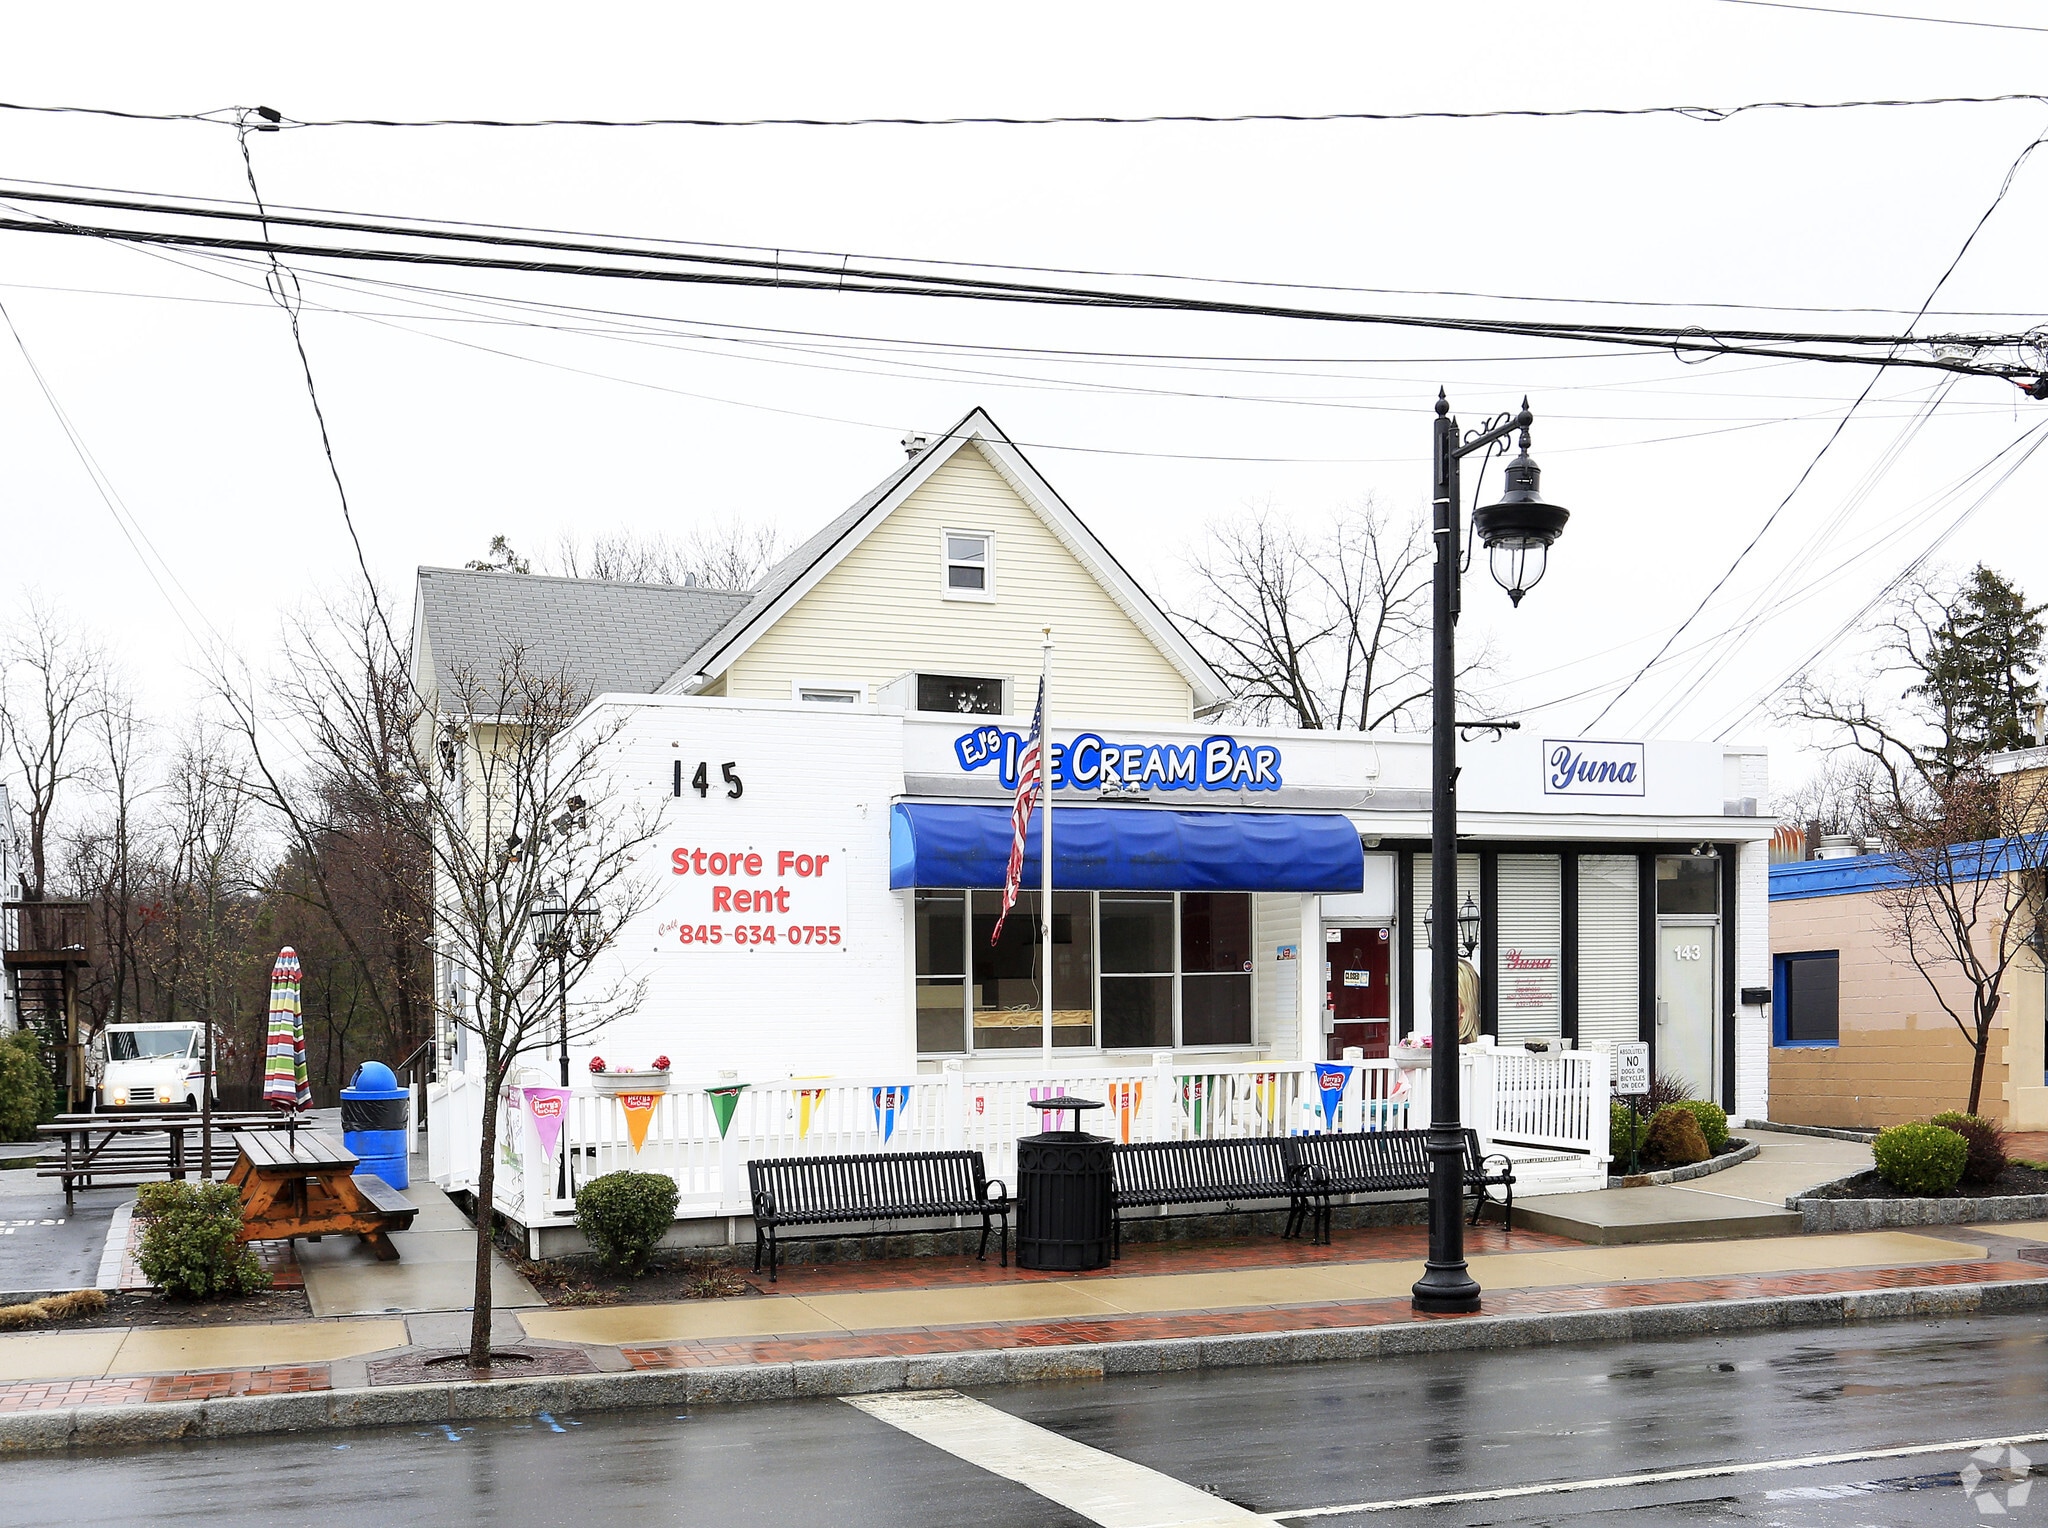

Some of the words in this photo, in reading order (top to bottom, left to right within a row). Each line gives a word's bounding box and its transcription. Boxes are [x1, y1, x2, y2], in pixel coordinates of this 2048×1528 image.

[1205, 740, 1277, 784] BAR
[1550, 745, 1638, 790] Yuna
[673, 759, 743, 799] 145
[671, 847, 763, 877] Store
[777, 850, 830, 878] For
[712, 885, 791, 914] Rent
[658, 918, 679, 937] Call
[679, 924, 842, 946] 845-634-0755
[1504, 948, 1553, 970] Yuna
[1674, 944, 1702, 962] 143
[1626, 1055, 1639, 1067] NO
[533, 1100, 559, 1112] Perry's
